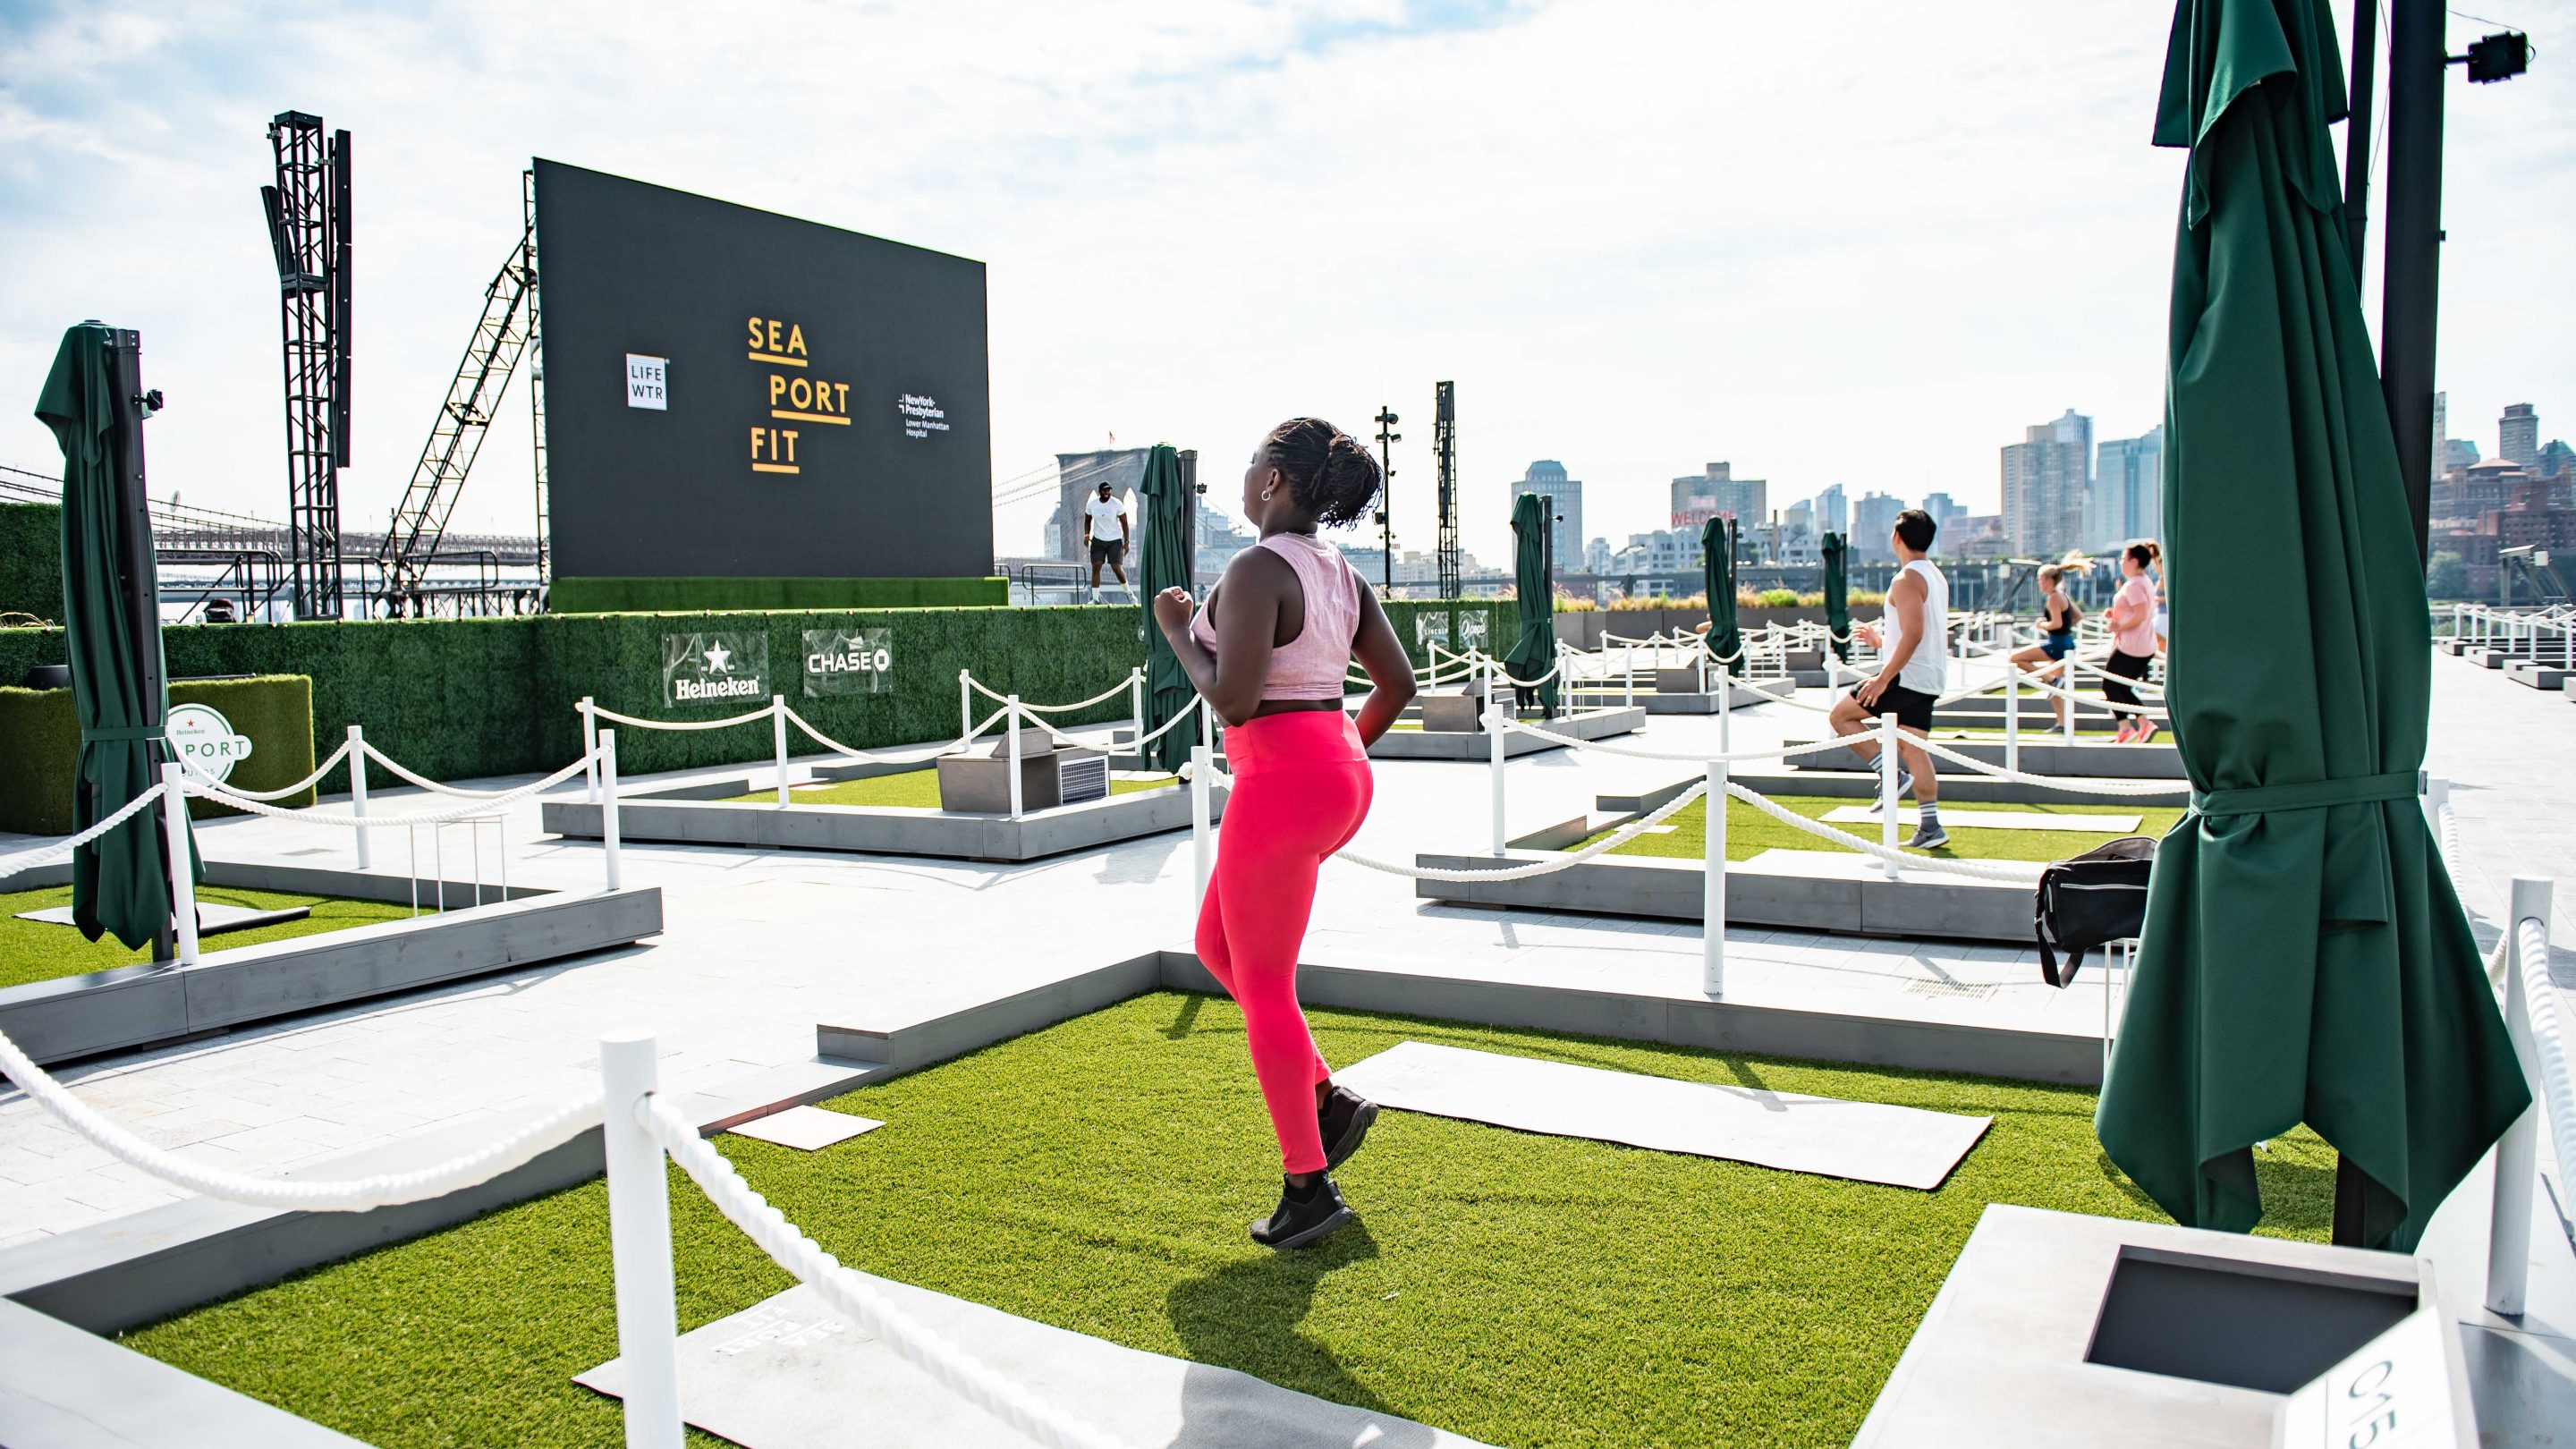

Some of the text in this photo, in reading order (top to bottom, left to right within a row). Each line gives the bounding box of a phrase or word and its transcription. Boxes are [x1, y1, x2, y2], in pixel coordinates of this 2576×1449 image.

[749, 317, 808, 356] SEA
[631, 365, 662, 381] LIFE
[631, 384, 663, 400] WTR
[770, 374, 850, 413] PORT
[905, 404, 945, 419] Presbyterian
[905, 419, 950, 431] Lower Manhattan
[905, 428, 928, 439] Hospital
[751, 427, 799, 462] FIT
[809, 651, 872, 673] CHASE
[675, 677, 759, 700] Heineken
